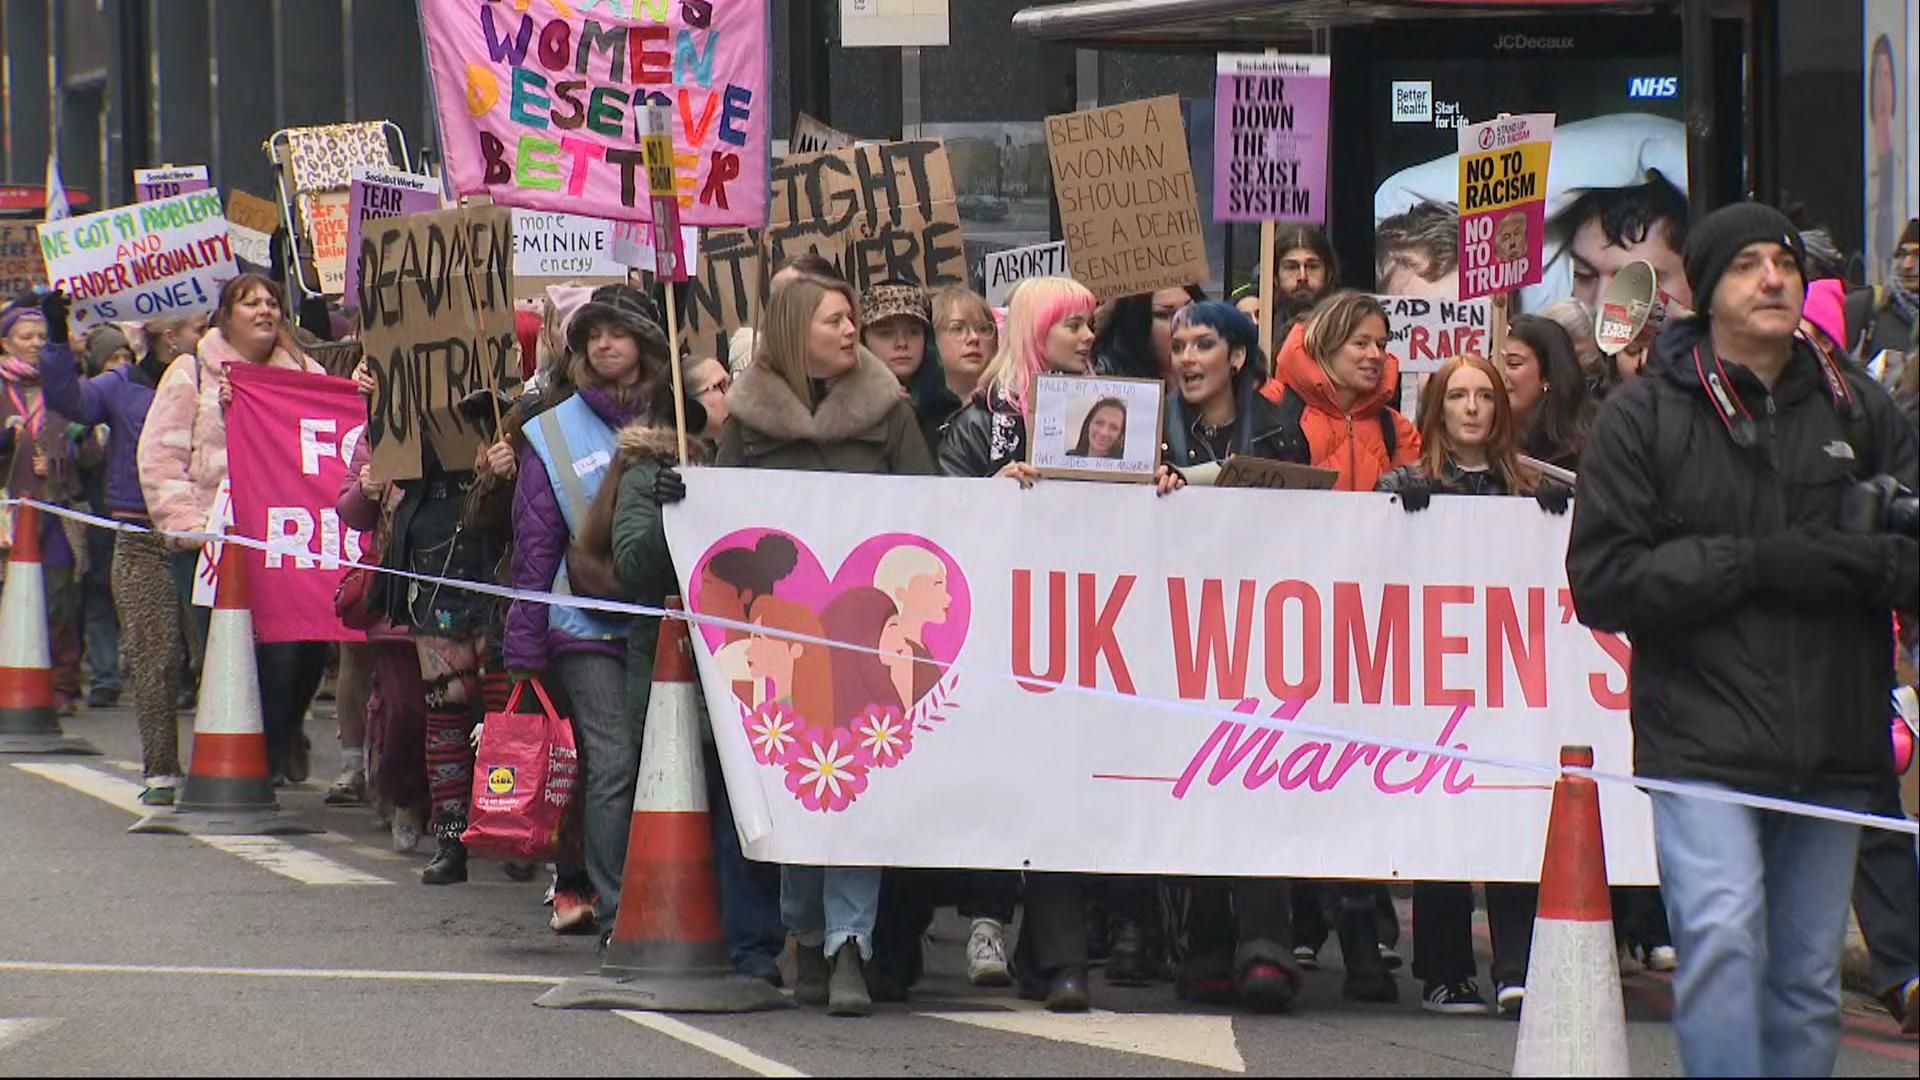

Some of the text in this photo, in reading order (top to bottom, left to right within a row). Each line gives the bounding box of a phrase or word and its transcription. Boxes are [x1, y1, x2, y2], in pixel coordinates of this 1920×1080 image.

[481, 5, 720, 86] WOMEN
[1493, 35, 1574, 49] JCDecaux
[1277, 62, 1310, 73] Worker
[1232, 76, 1284, 101] TEAR
[1397, 89, 1427, 101] Better
[1630, 77, 1677, 97] NHS
[1232, 105, 1293, 129] DOWN
[1397, 101, 1427, 115] Health
[1435, 101, 1460, 114] Start
[1049, 105, 1160, 146] BEING A
[1435, 115, 1469, 129] for Life
[1231, 132, 1268, 157] THE
[480, 131, 740, 210] BETTER
[1055, 141, 1164, 181] WOMAN
[1230, 161, 1300, 185] SEXIST
[1466, 150, 1522, 184] NO TO
[365, 171, 424, 189] Socialist Worker
[1062, 171, 1191, 214] SHOULDNT
[1466, 172, 1536, 210] RACISM
[362, 183, 402, 212] TEAR
[1229, 188, 1309, 215] SYSTEM
[74, 217, 111, 249] GOT
[114, 213, 136, 241] 99
[141, 194, 222, 233] PROBLEMS
[520, 215, 565, 230] more
[1066, 208, 1200, 253] BE A DEATH
[1465, 216, 1493, 244] NO
[116, 234, 161, 261] AND
[513, 231, 604, 253] EMININE
[1465, 244, 1490, 268] TO
[54, 263, 133, 300] GENDER
[131, 232, 232, 286] INEQUALITY
[540, 256, 593, 273] energy
[992, 245, 1064, 288] ABORTI
[1074, 241, 1197, 282] SENTENCE
[358, 221, 447, 331] DEAD
[1466, 257, 1529, 295] TRUMP
[94, 277, 208, 318] IS ONE!
[1381, 298, 1484, 326] EAD MEN
[1386, 323, 1485, 360] ONT RAPE
[1011, 569, 1632, 711] UK WOMEN'S
[1172, 697, 1475, 799] March
